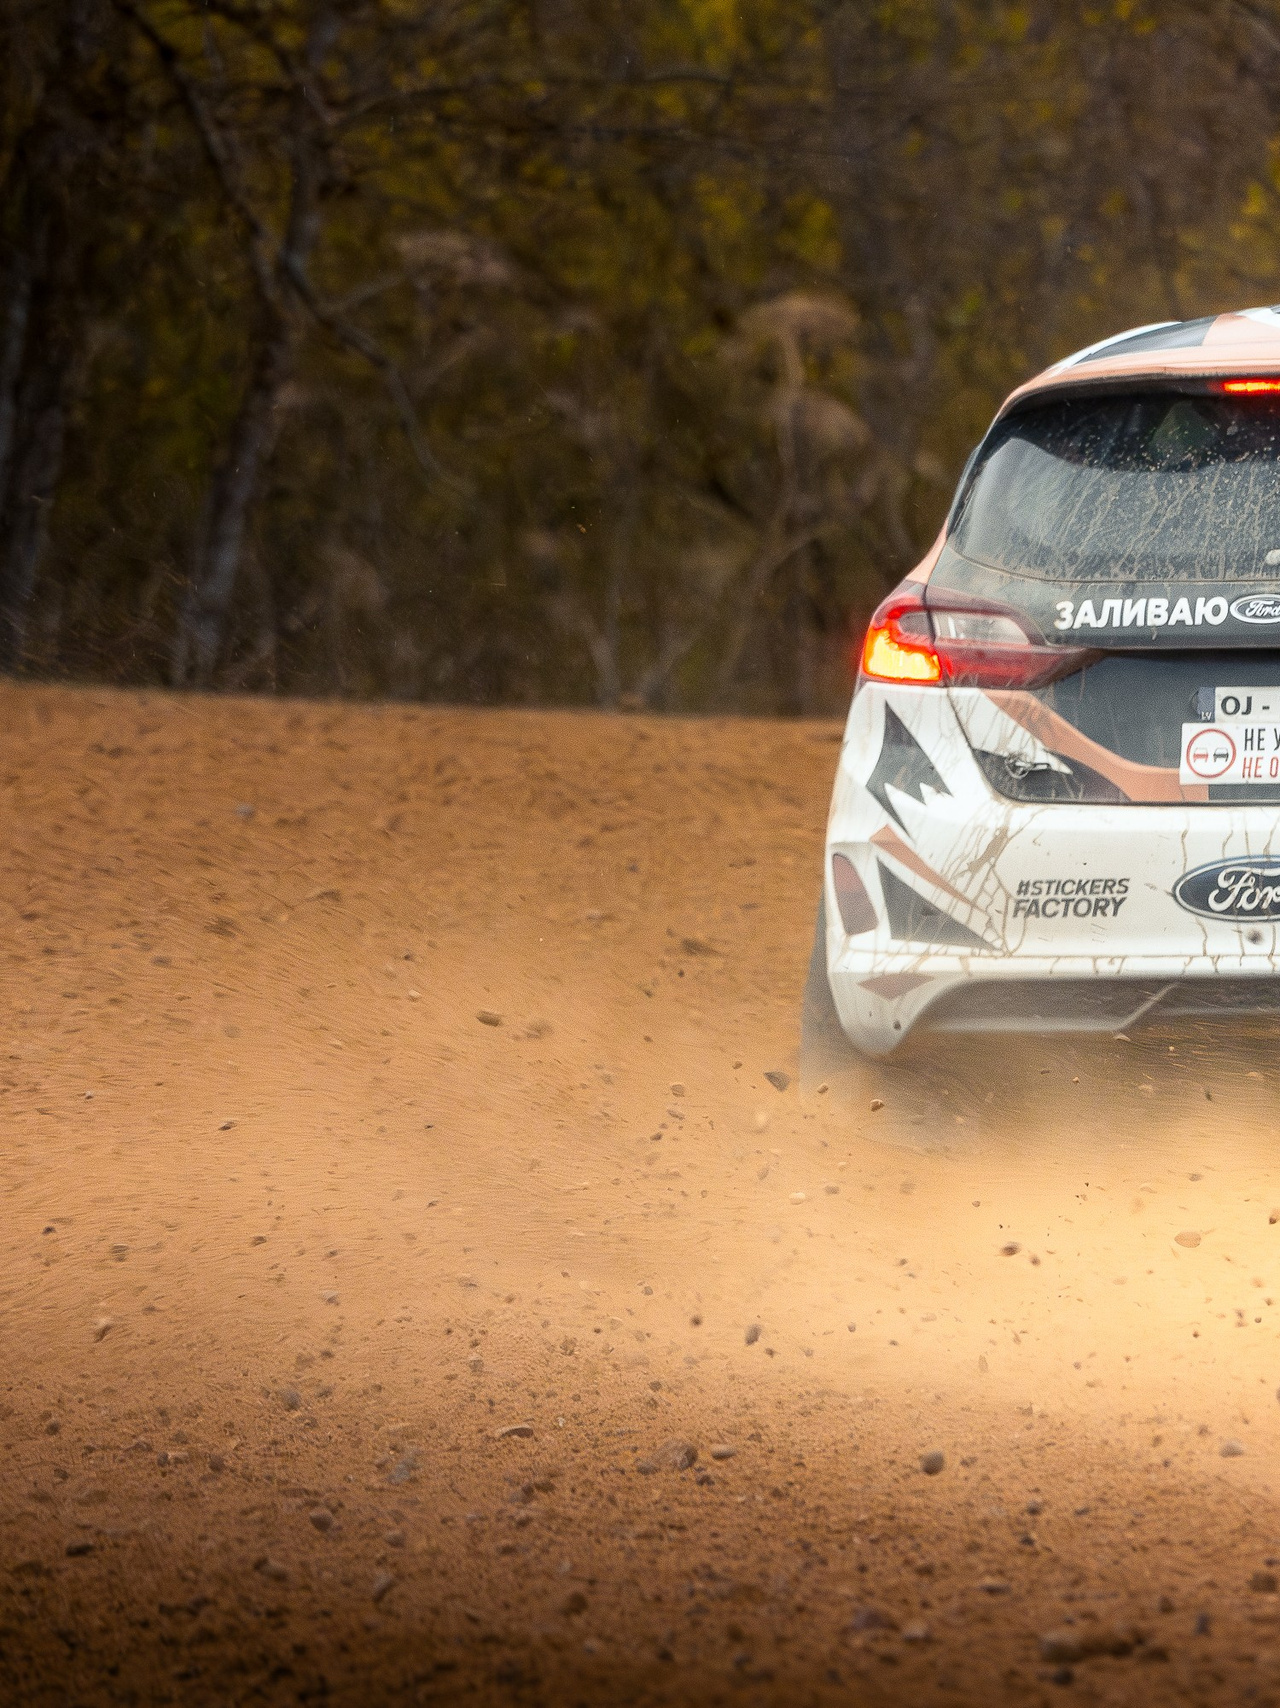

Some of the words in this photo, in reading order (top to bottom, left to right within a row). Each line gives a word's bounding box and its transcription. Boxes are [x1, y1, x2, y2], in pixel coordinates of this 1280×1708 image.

[1053, 596, 1229, 631] ЗАЛИВАЮ
[1201, 711, 1212, 720] LV
[1220, 695, 1253, 716] OJ
[1244, 728, 1266, 751] НЕ
[1242, 757, 1263, 779] НЕ
[1016, 878, 1130, 896] #STICKERS
[1012, 897, 1127, 918] FACTORY
